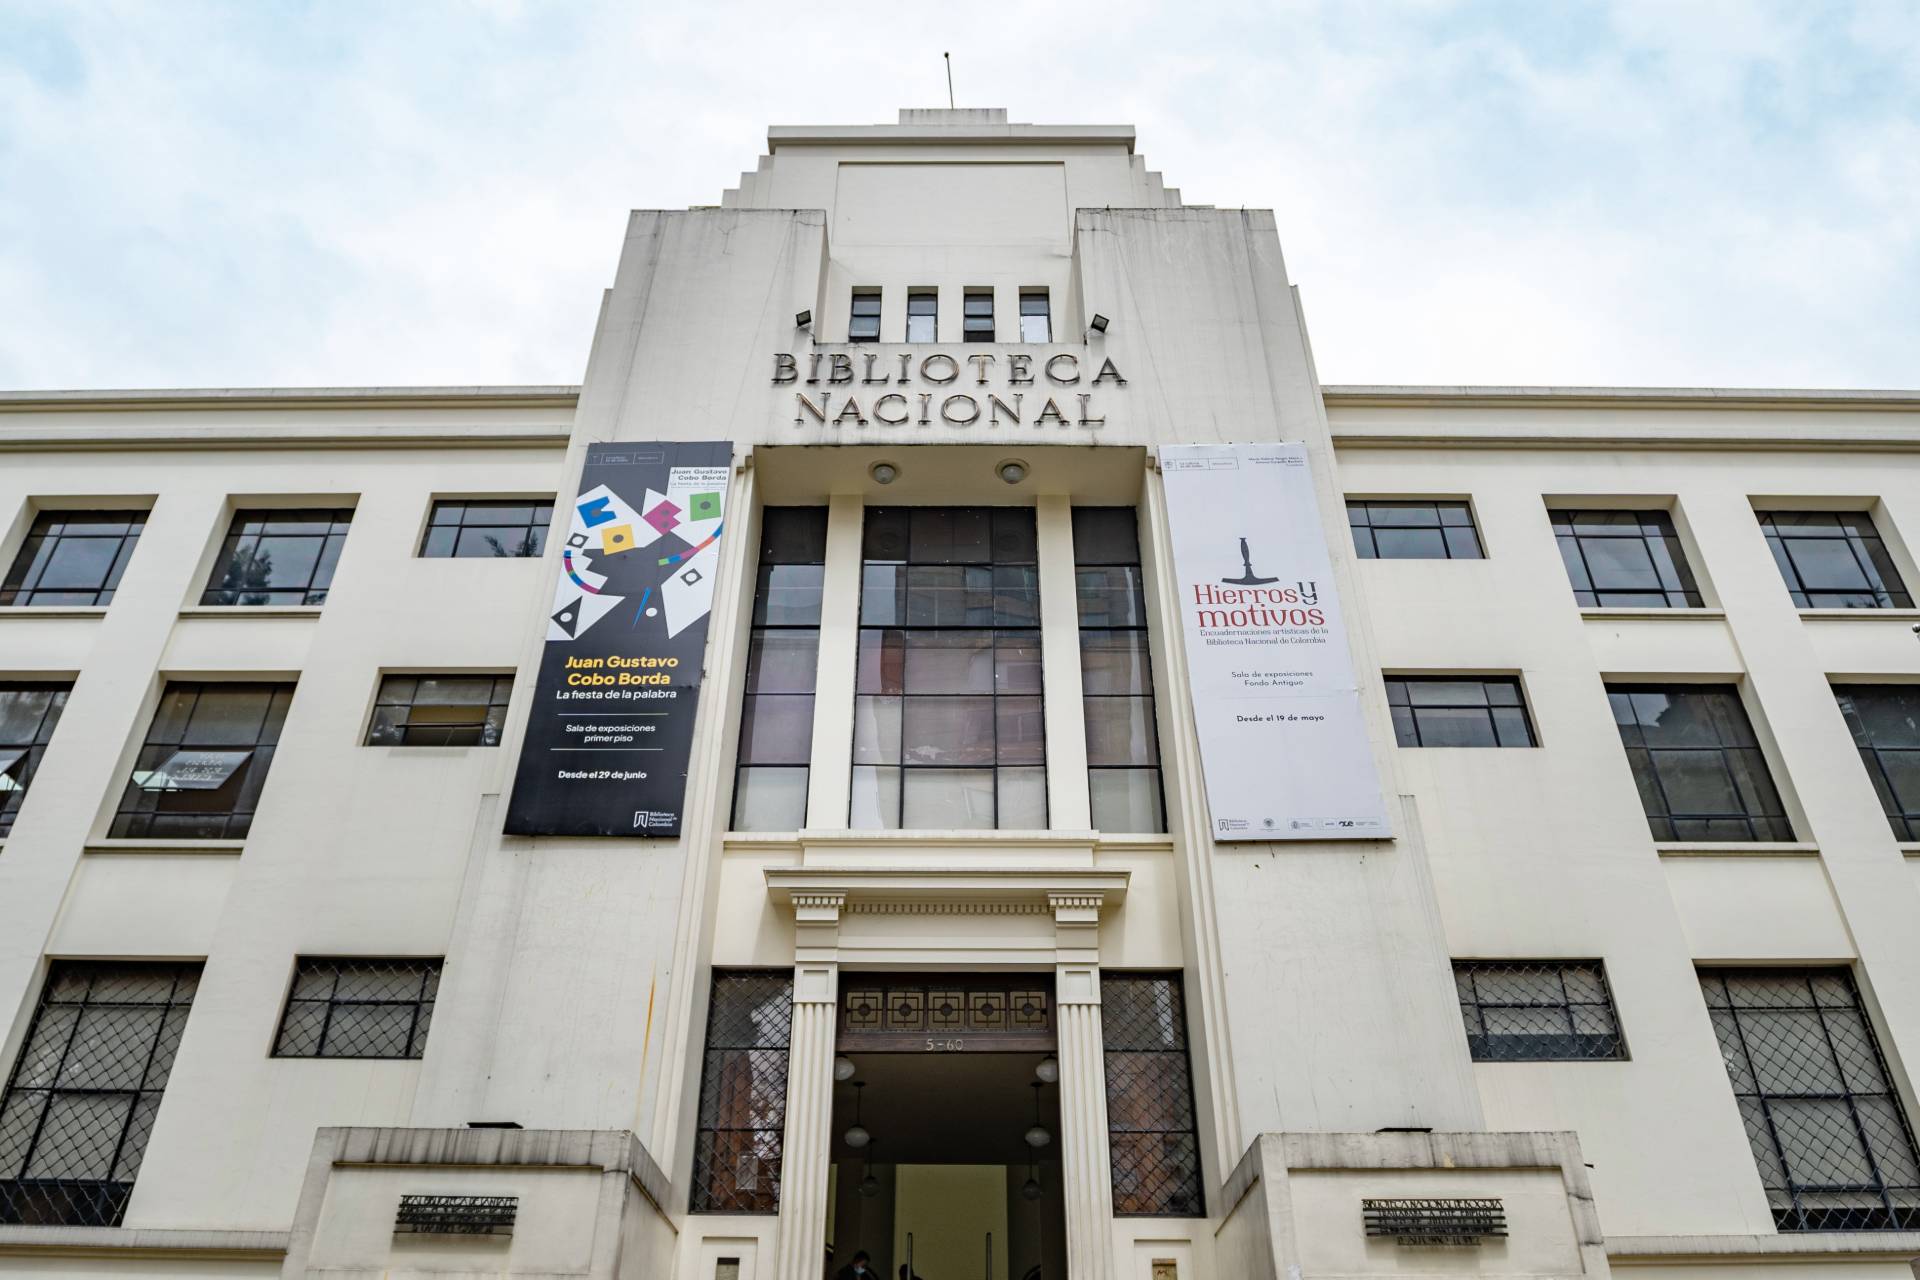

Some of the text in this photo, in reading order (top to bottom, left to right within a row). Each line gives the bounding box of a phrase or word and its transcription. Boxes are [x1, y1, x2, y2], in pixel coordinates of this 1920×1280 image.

[771, 353, 1128, 385] BIBLIOTECA
[794, 392, 1106, 425] NACIONAL
[1192, 582, 1318, 605] Hierros y
[1197, 603, 1325, 628] motivos
[1200, 629, 1271, 637] Encuadernaciones
[565, 656, 678, 668] Juan Gustavo
[567, 672, 671, 686] Cobo Borda
[556, 689, 677, 700] La fiesta de la palabra
[565, 724, 656, 733] Sala de exposiciones
[584, 735, 633, 743] primer piso
[558, 770, 647, 780] Desde el 29 de junio
[926, 1039, 964, 1050] 5-60
